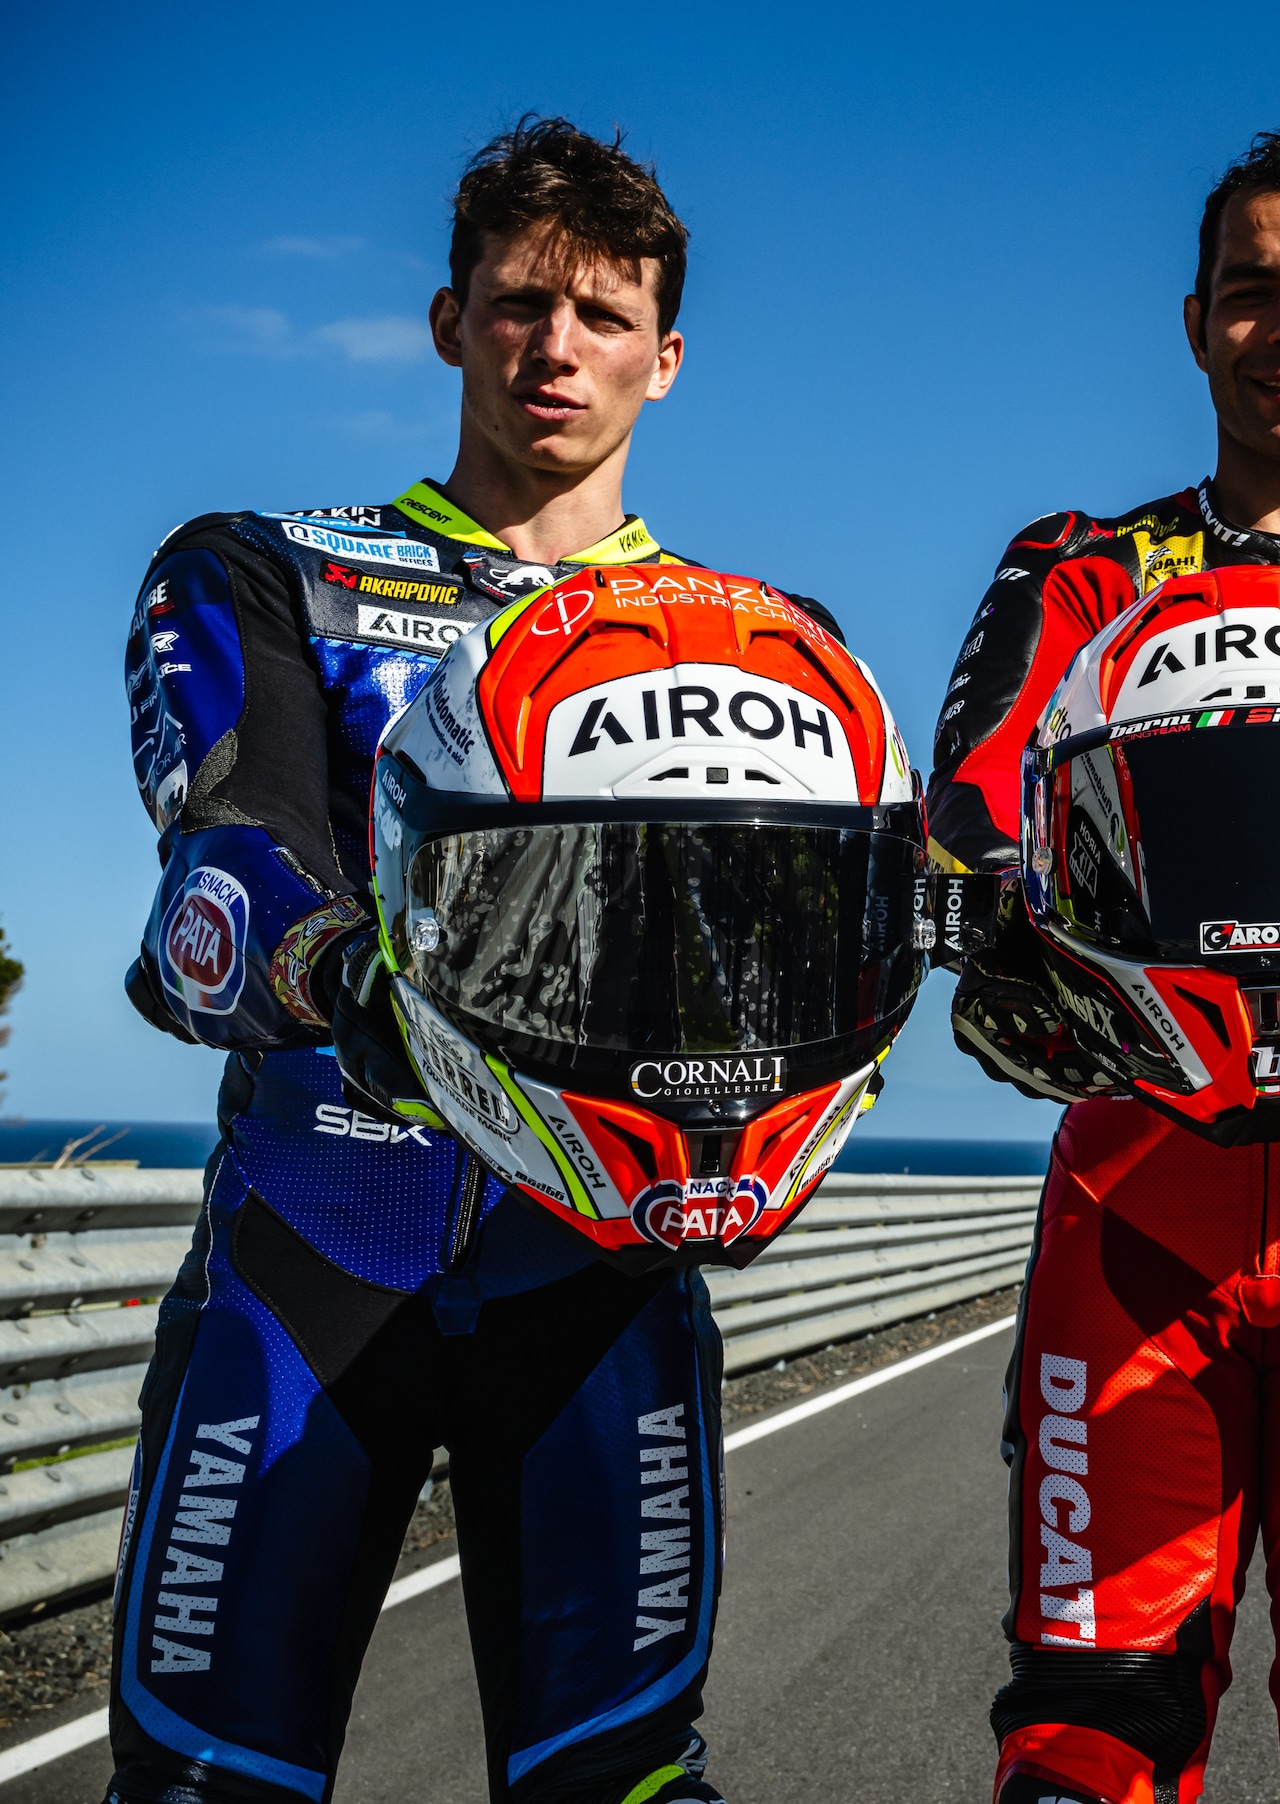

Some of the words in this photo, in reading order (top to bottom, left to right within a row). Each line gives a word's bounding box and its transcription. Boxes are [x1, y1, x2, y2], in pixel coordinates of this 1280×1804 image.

[400, 498, 452, 524] CRESCENT
[312, 530, 395, 560] SQUARE
[396, 545, 432, 559] BRICK
[369, 612, 464, 646] AIRO
[615, 593, 749, 613] INDUSTRIA
[433, 672, 475, 755] fluidomatic
[568, 686, 833, 758] AIROH
[382, 769, 407, 808] AIROH
[199, 870, 238, 907] SNACK
[944, 879, 964, 951] AIROH
[173, 906, 221, 975] PATA
[1132, 984, 1185, 1051] AIROH
[632, 1056, 785, 1098] CORNALI
[664, 1084, 768, 1096] GIOIELLERIE
[314, 1103, 433, 1147] SBK
[548, 1114, 606, 1190] AIROH
[789, 1105, 841, 1180] AIROH
[661, 1207, 743, 1238] PATA
[633, 1403, 691, 1652] YAMAHA
[1038, 1353, 1096, 1648] DUCATI
[151, 1415, 260, 1673] YAMAHA
